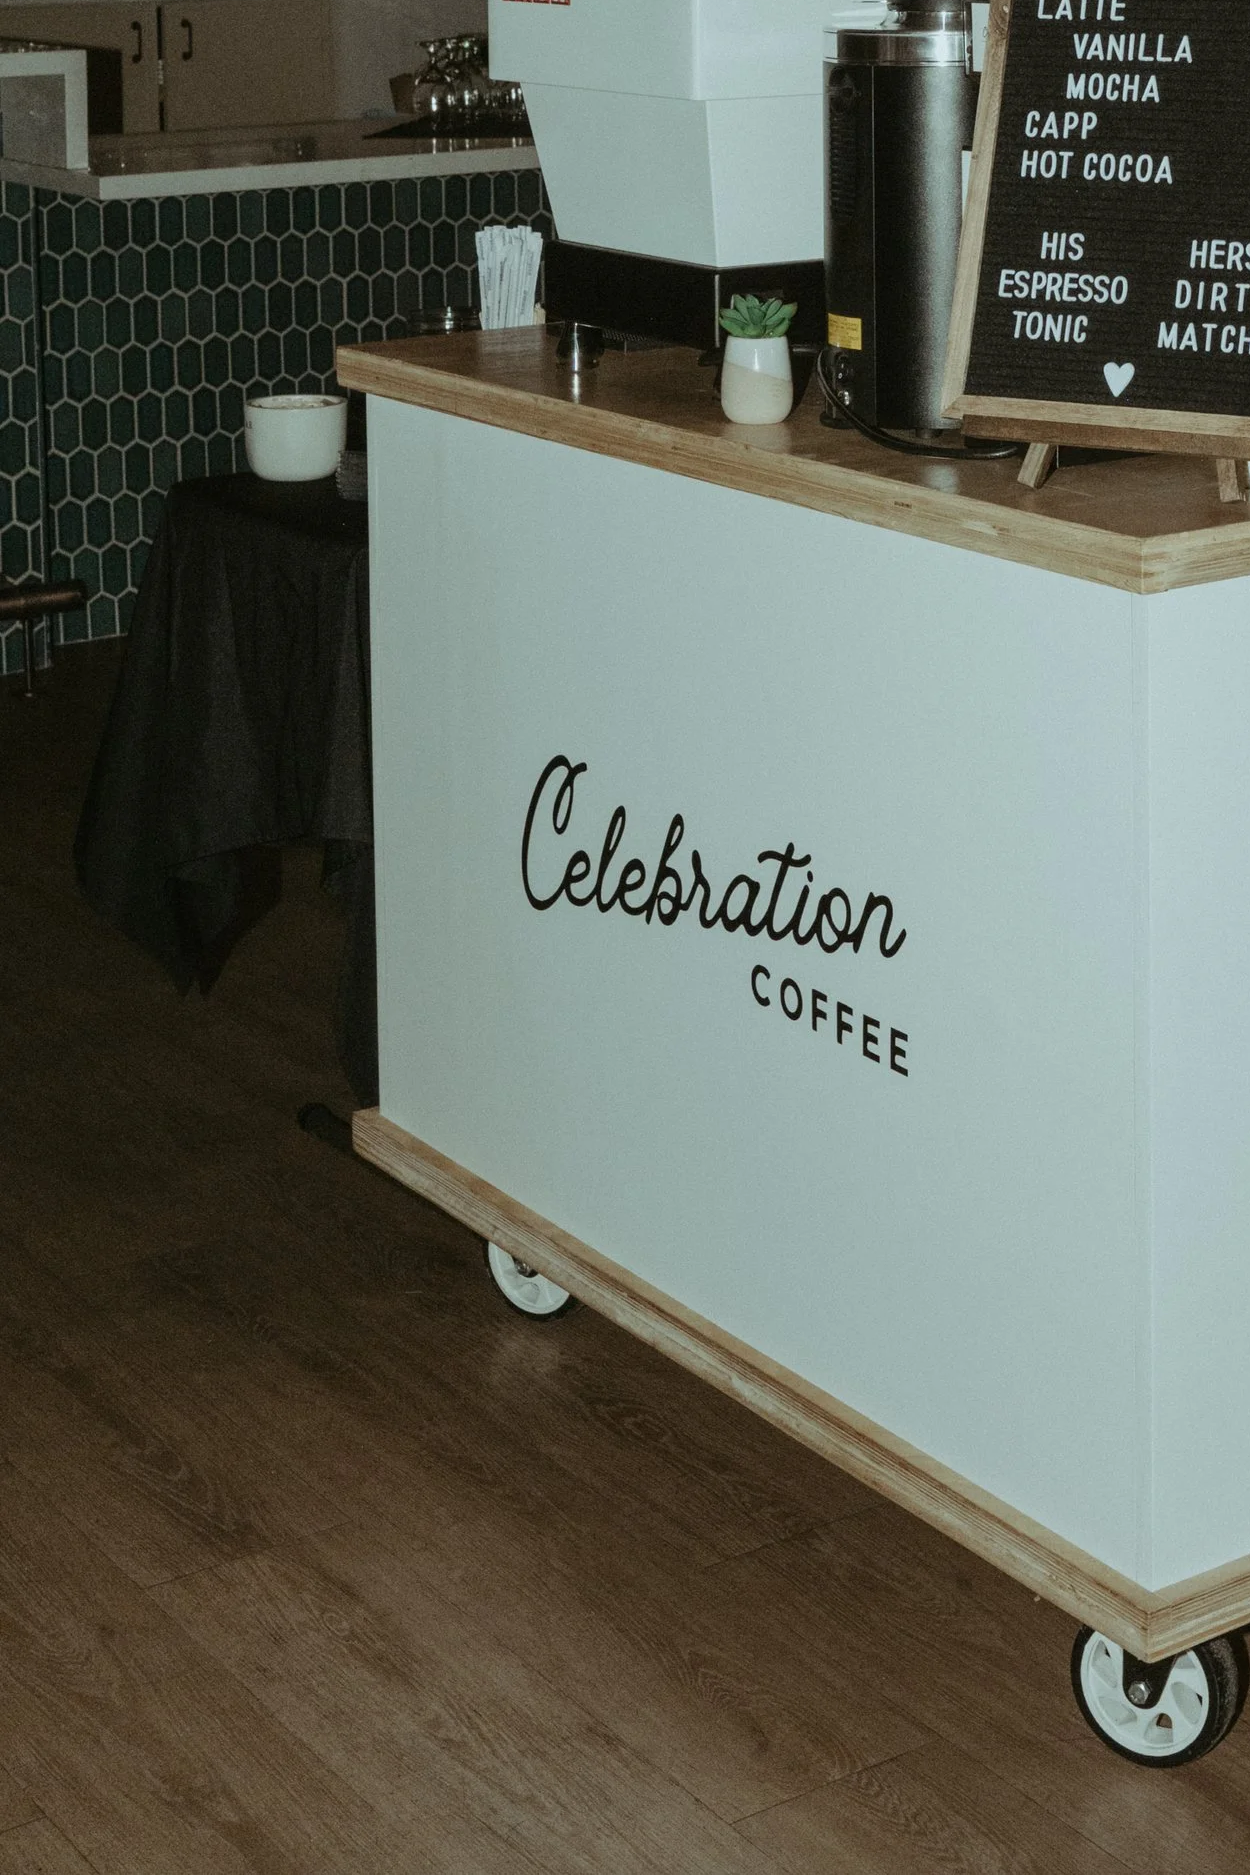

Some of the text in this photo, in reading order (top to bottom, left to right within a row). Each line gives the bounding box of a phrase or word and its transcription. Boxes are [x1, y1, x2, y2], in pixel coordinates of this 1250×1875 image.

[1073, 32, 1193, 64] VANILLA
[1065, 72, 1160, 103] MOCHA
[1024, 110, 1098, 140] CAPP
[1020, 149, 1173, 185] HOT COCOA
[1040, 231, 1085, 261] HIS
[998, 268, 1129, 305] ESPRESSO
[1012, 310, 1089, 344] TONIC
[521, 754, 907, 959] Celebration
[751, 964, 909, 1077] COFFEE
